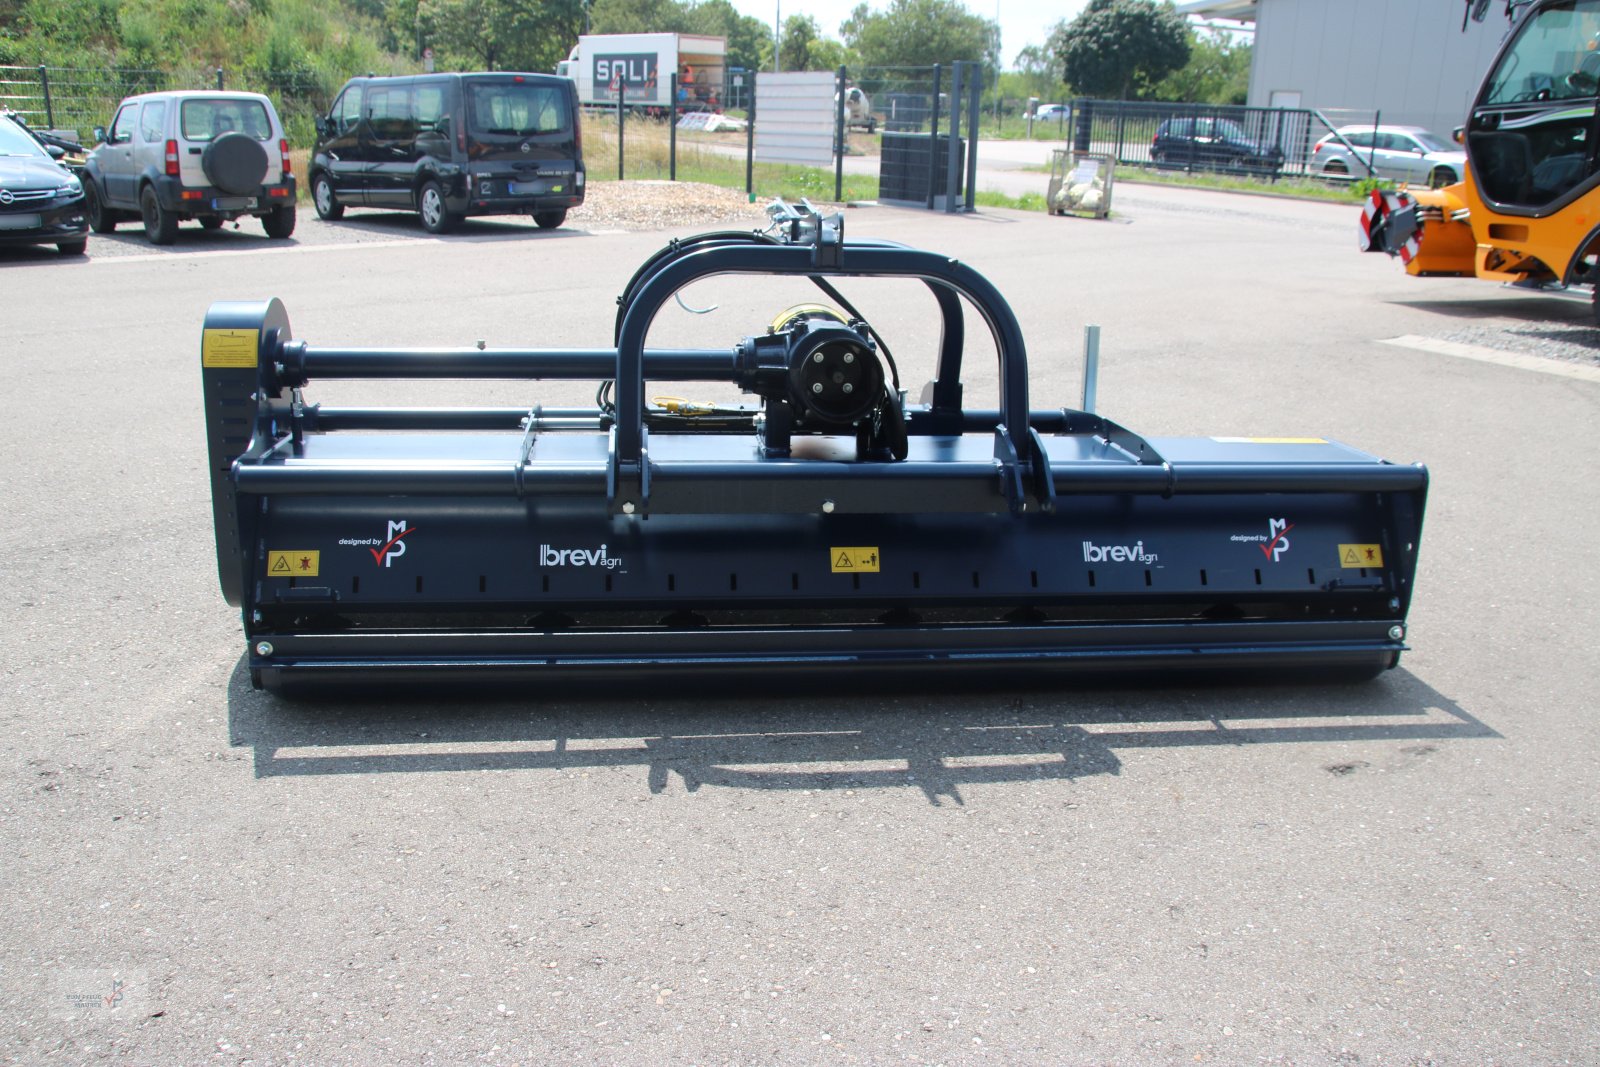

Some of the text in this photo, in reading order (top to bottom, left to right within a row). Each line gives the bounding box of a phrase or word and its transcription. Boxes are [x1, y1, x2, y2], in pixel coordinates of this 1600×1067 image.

[597, 60, 647, 81] SOLI
[338, 538, 382, 546] designed by
[600, 558, 622, 570] agri
[1138, 554, 1158, 565] agri
